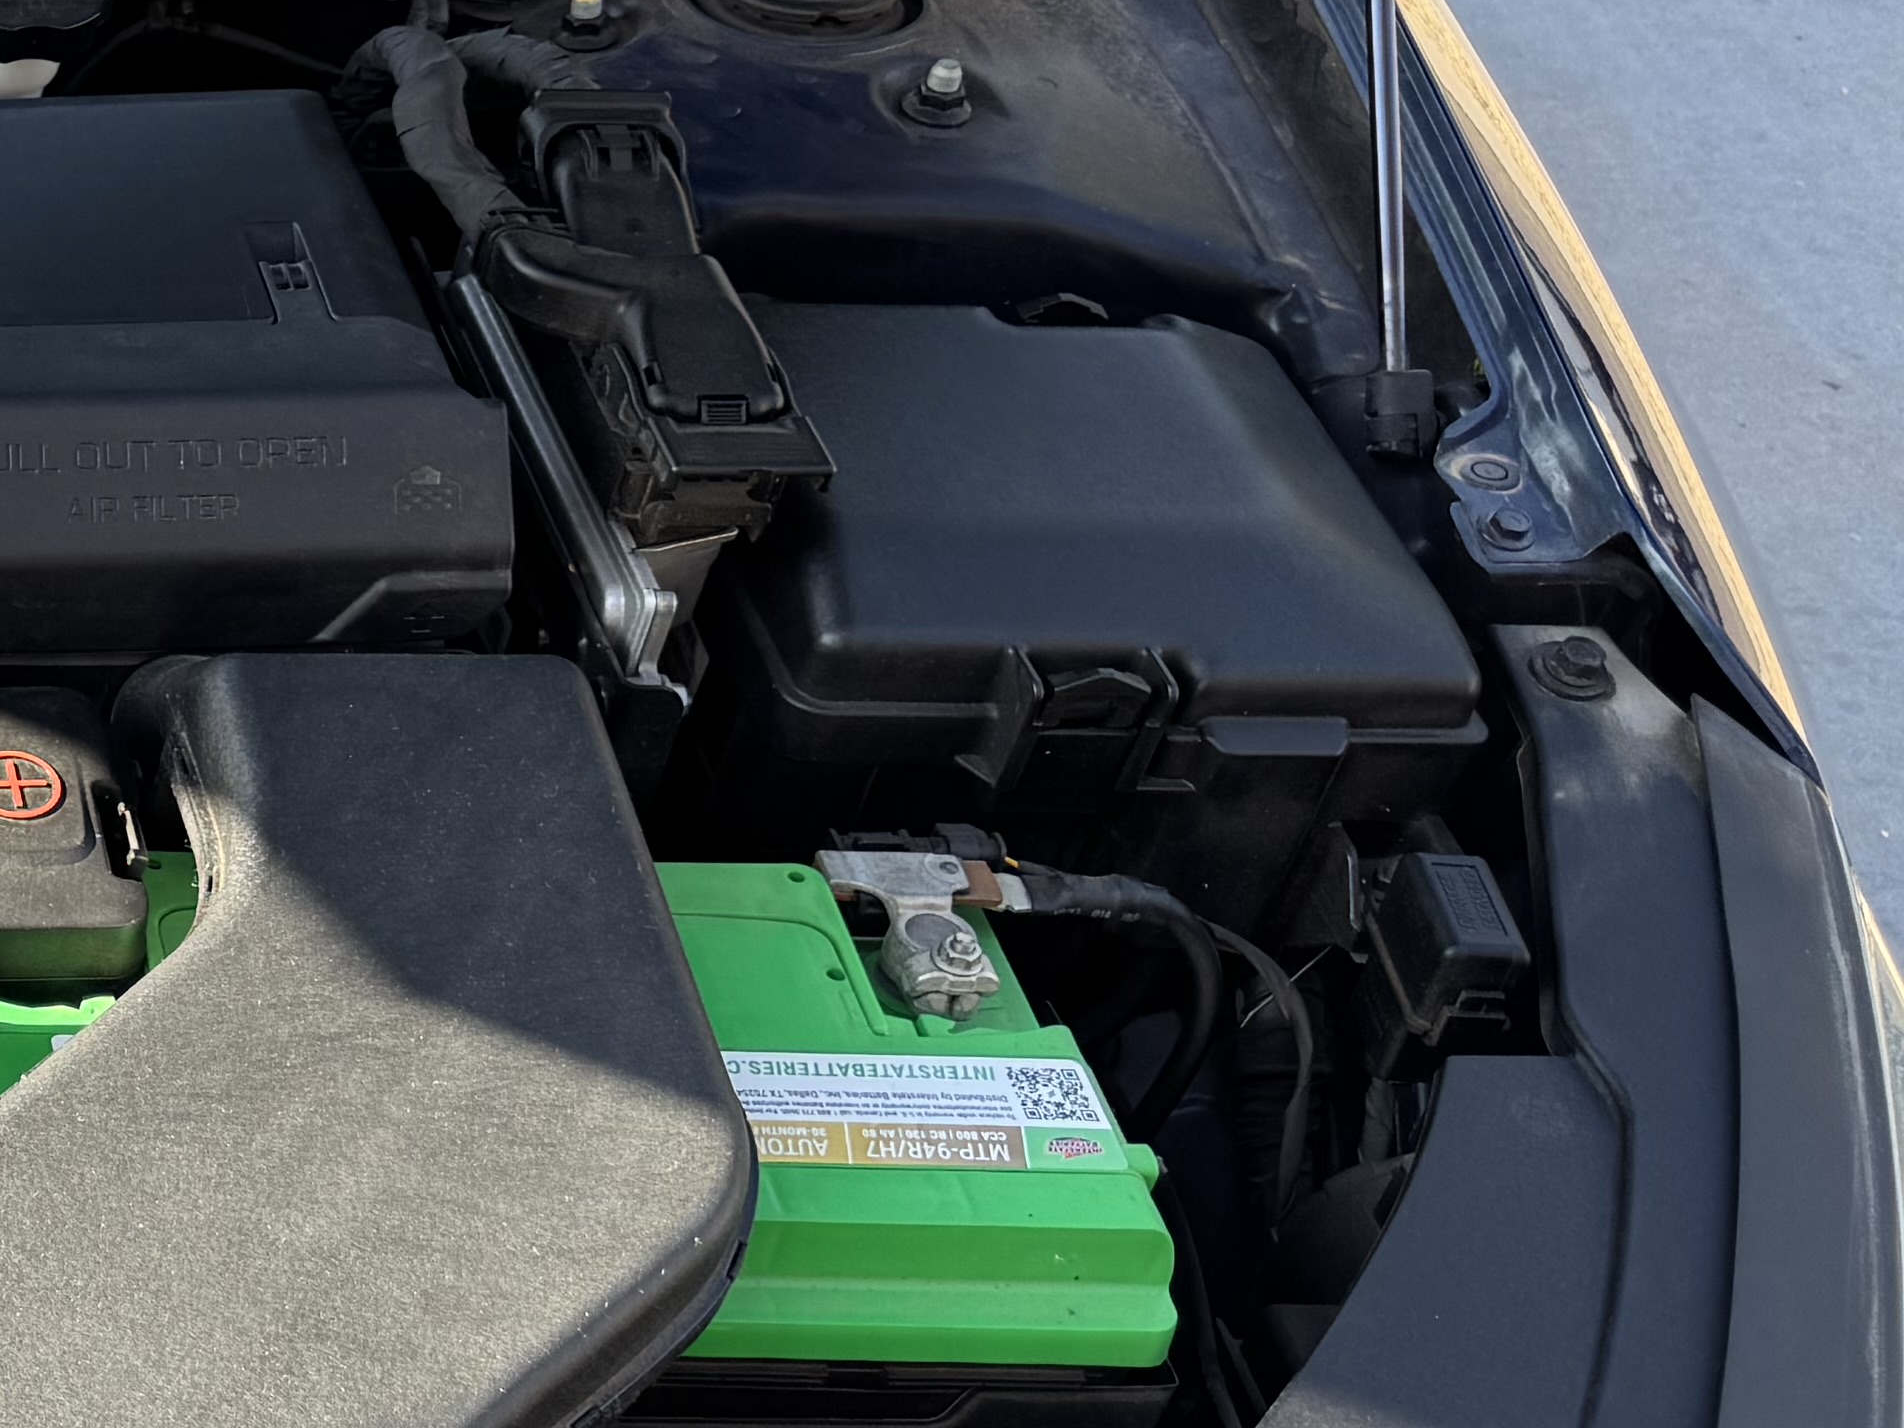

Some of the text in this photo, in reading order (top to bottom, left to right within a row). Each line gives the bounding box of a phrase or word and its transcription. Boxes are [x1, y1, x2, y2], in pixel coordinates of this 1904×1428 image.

[74, 440, 157, 472] OUT
[167, 439, 223, 470] TO
[236, 435, 348, 469] OPEN
[68, 493, 240, 524] AIR FILTER
[981, 1131, 1007, 1141] CCA
[866, 1139, 1011, 1162] MTP-94R/H7
